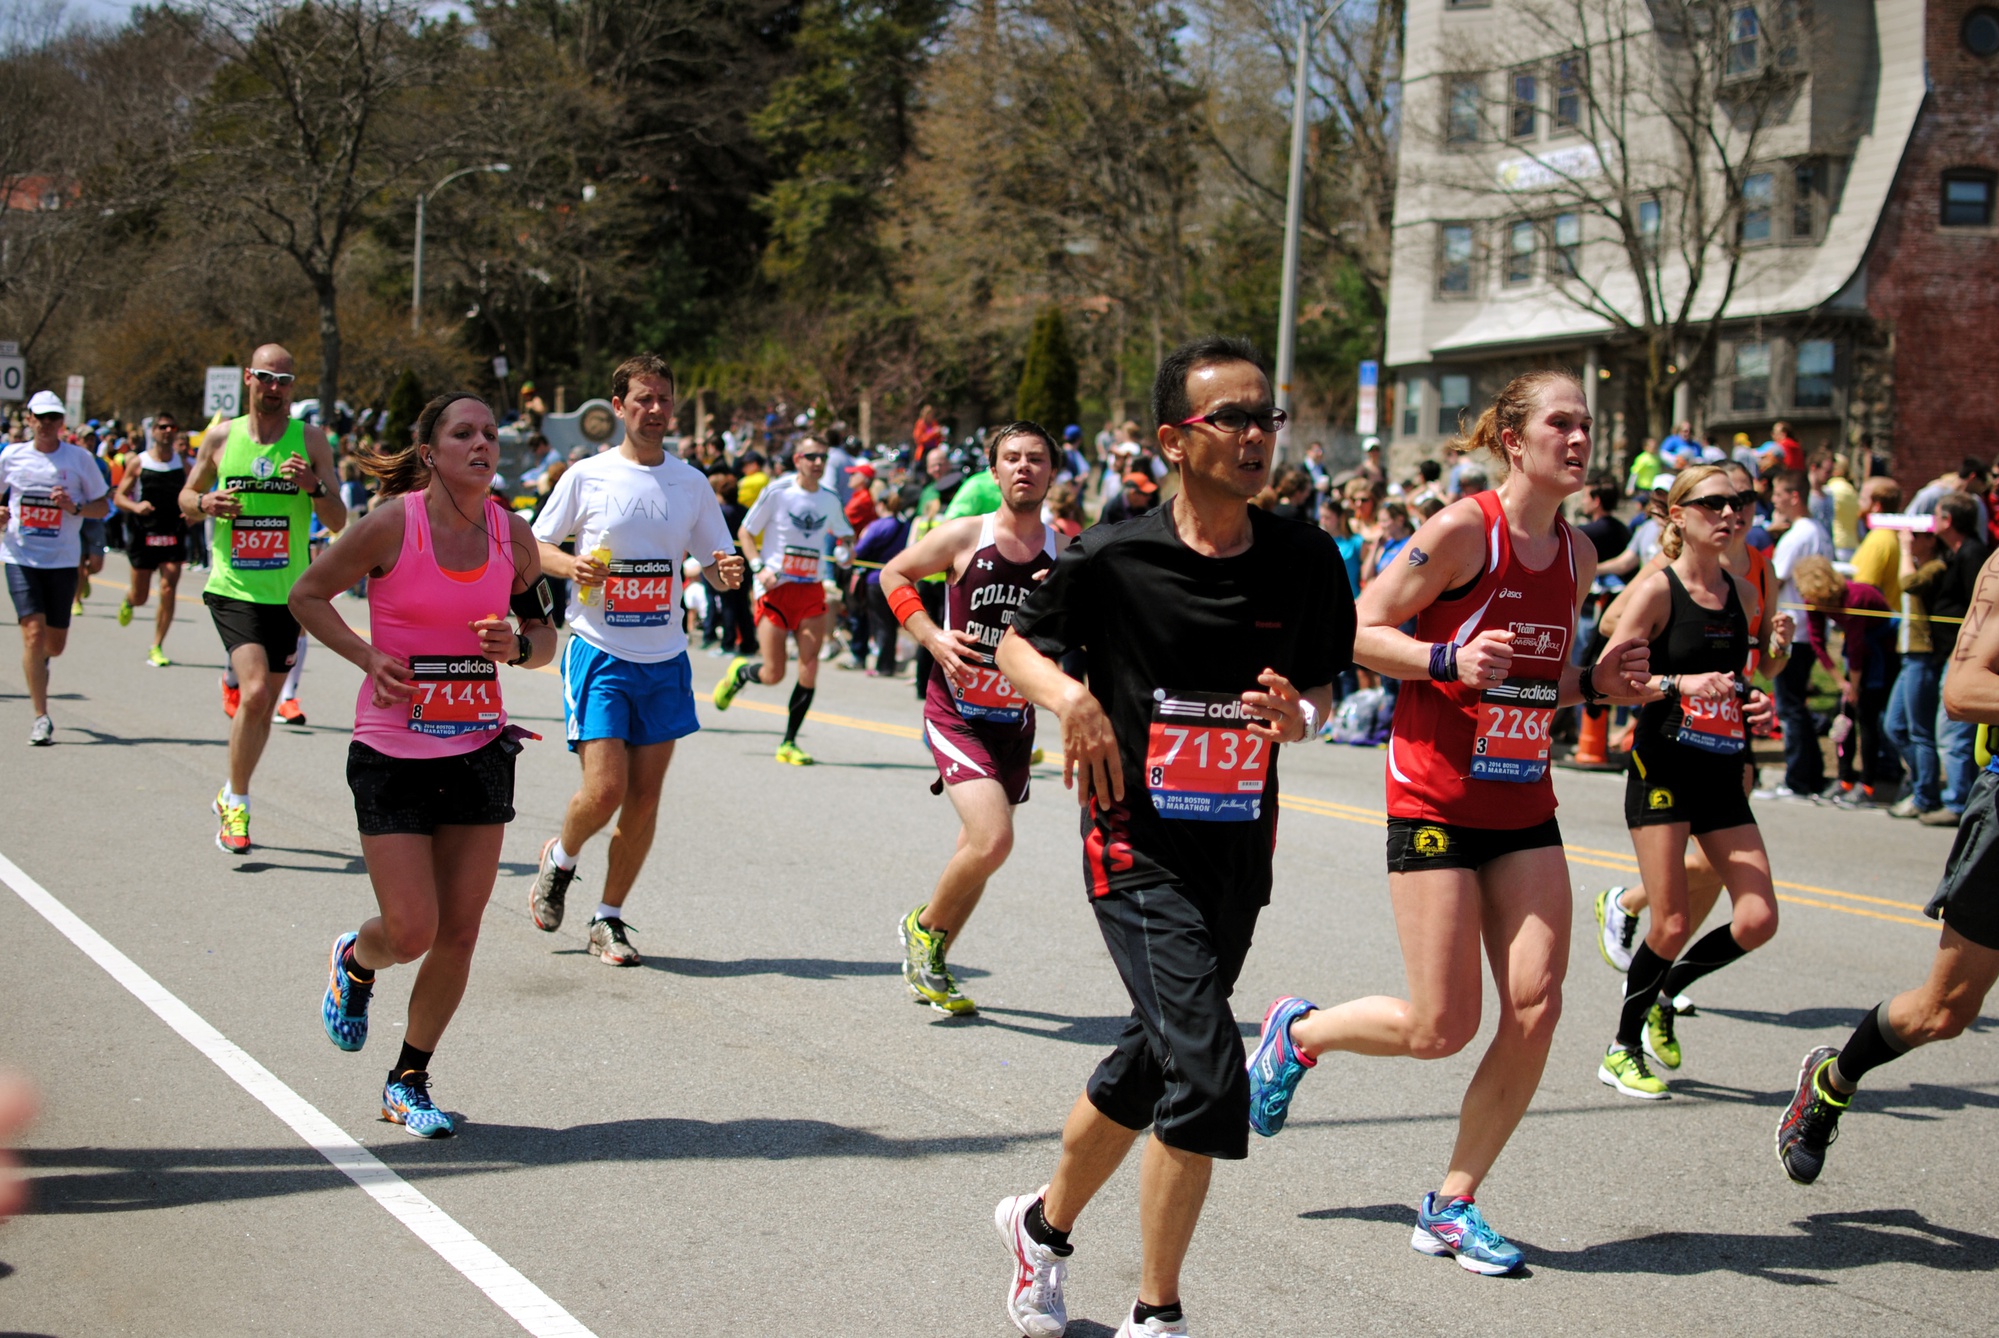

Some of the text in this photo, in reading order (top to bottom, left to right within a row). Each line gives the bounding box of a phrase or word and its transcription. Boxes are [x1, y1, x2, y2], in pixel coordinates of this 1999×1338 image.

[0, 366, 20, 390] 0
[210, 393, 235, 411] 30
[22, 506, 59, 521] 5427
[605, 494, 668, 521] IVAN
[254, 518, 287, 527] adidas
[236, 531, 285, 549] 3672
[634, 562, 670, 573] adidas
[610, 579, 667, 600] 4844
[606, 600, 614, 611] 5
[1001, 609, 1015, 624] OF
[1516, 623, 1536, 635] Team
[448, 660, 494, 674] adidas
[418, 683, 490, 705] 7141
[956, 687, 964, 699] 6
[1519, 685, 1557, 701] adidas
[413, 704, 422, 719] 8
[1486, 707, 1551, 740] 2266
[1684, 715, 1692, 728] 6
[1163, 728, 1264, 770] 7132
[1476, 738, 1486, 754] 3
[1151, 767, 1163, 786] 8
[1487, 767, 1520, 775] MARATHON
[1166, 802, 1211, 812] MARATHON
[1184, 797, 1211, 805] BOSTON
